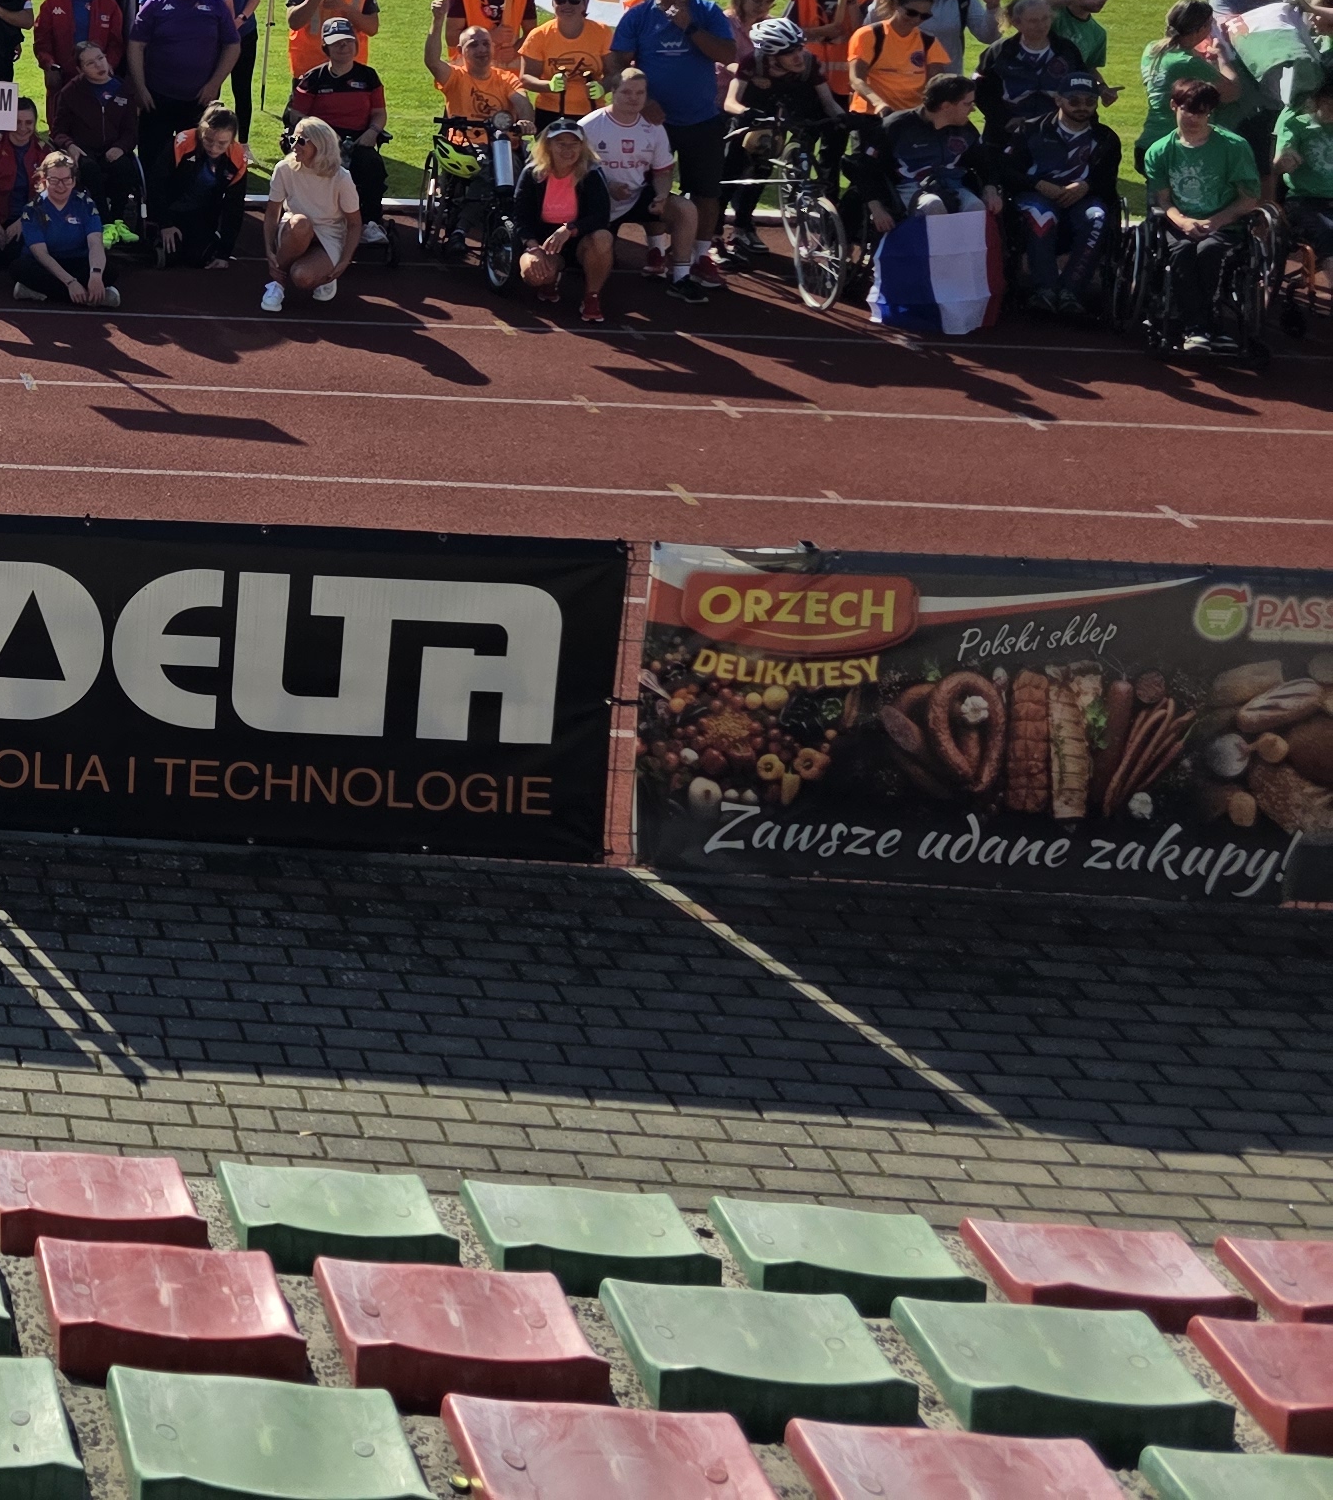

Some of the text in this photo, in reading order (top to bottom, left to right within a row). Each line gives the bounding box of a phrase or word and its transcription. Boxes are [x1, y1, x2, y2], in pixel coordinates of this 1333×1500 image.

[698, 586, 896, 633] ORZECH
[957, 613, 1118, 661] Polski sklep
[693, 649, 879, 687] DELIKATESY
[128, 756, 134, 793] I
[155, 757, 553, 816] TECHNOLOGIE
[704, 801, 1304, 897] Zawsze udane zakupy!
